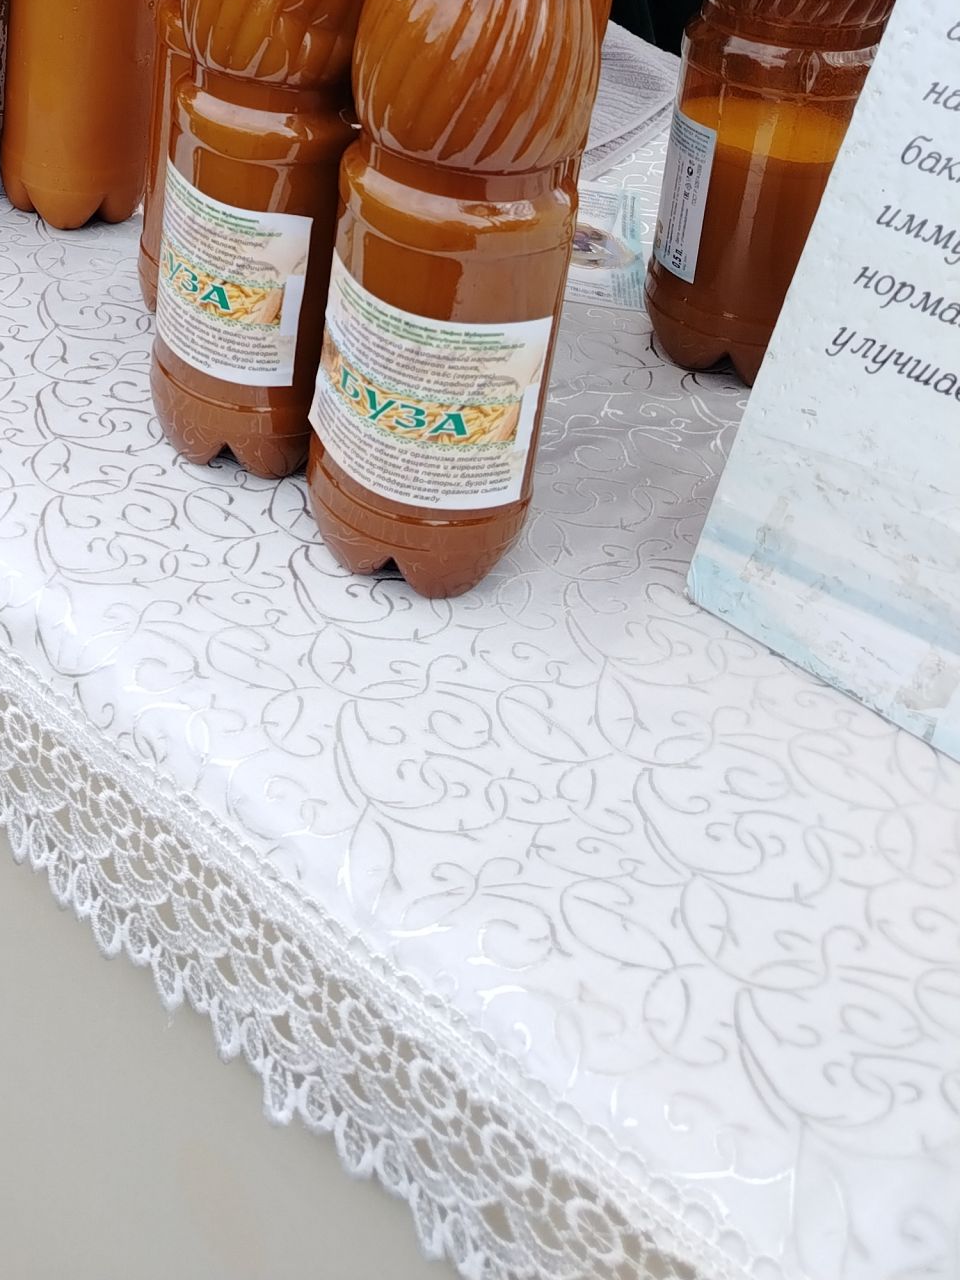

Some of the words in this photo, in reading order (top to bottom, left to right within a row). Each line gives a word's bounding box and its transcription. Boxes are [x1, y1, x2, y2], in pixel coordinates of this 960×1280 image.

[900, 135, 960, 184] бак
[853, 266, 960, 328] норма
[825, 326, 960, 402] улучша
[339, 366, 470, 438] БУЗА
[409, 452, 456, 464] организма
